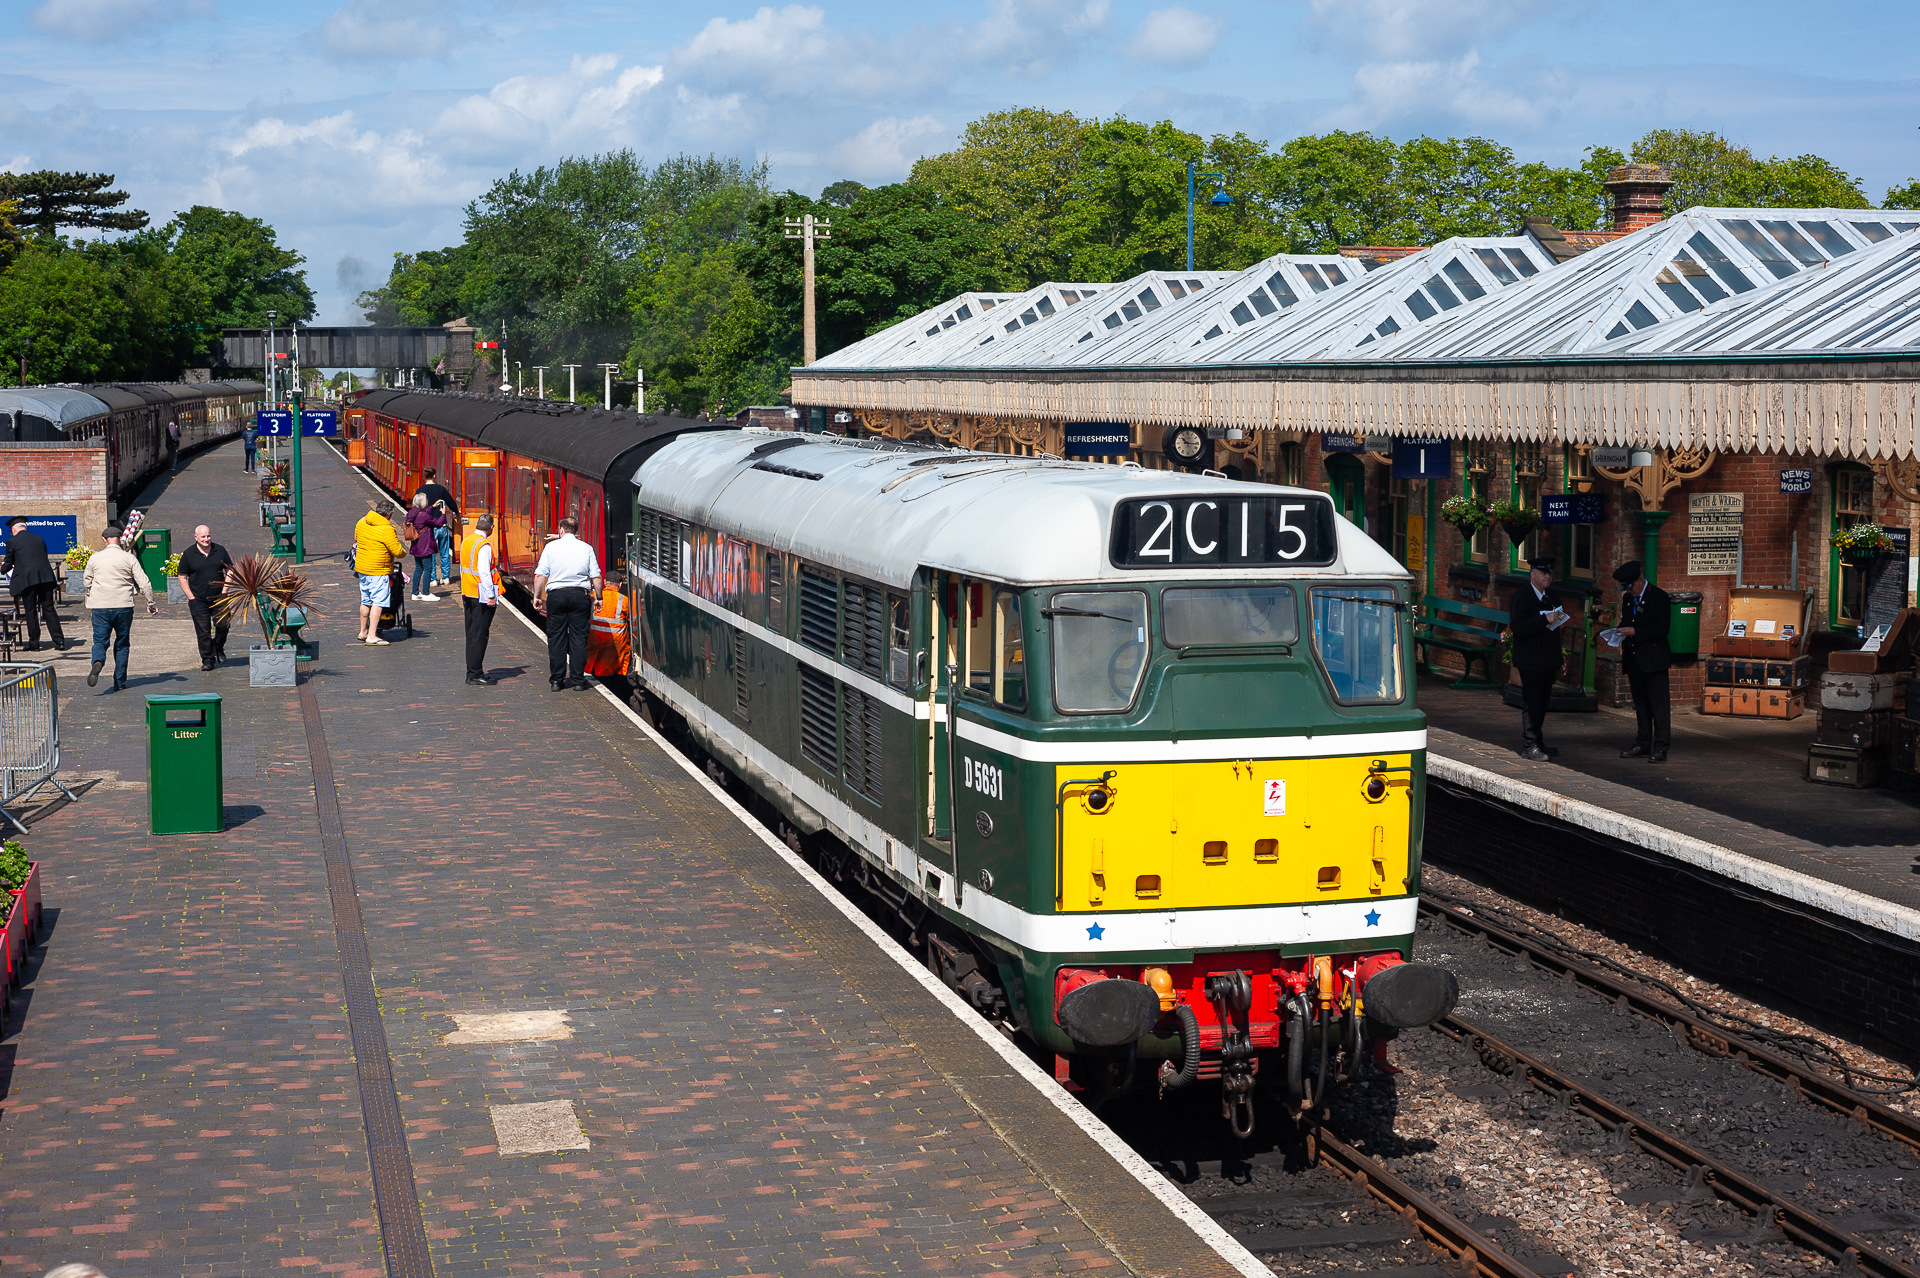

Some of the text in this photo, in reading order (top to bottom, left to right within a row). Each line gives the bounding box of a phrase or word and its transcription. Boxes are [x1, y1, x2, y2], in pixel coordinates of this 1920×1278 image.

[270, 419, 279, 433] 3
[314, 419, 324, 433] 2
[1067, 435, 1129, 443] REFRESHMENTS
[1420, 449, 1425, 474] 1
[1595, 454, 1626, 463] SHERINGHAM
[1781, 470, 1810, 480] NEWS
[1781, 481, 1811, 491] WORLD
[1711, 495, 1717, 506] &
[1719, 495, 1741, 506] WRIGHT
[174, 731, 199, 739] Litter
[964, 755, 1003, 801] D 5631
